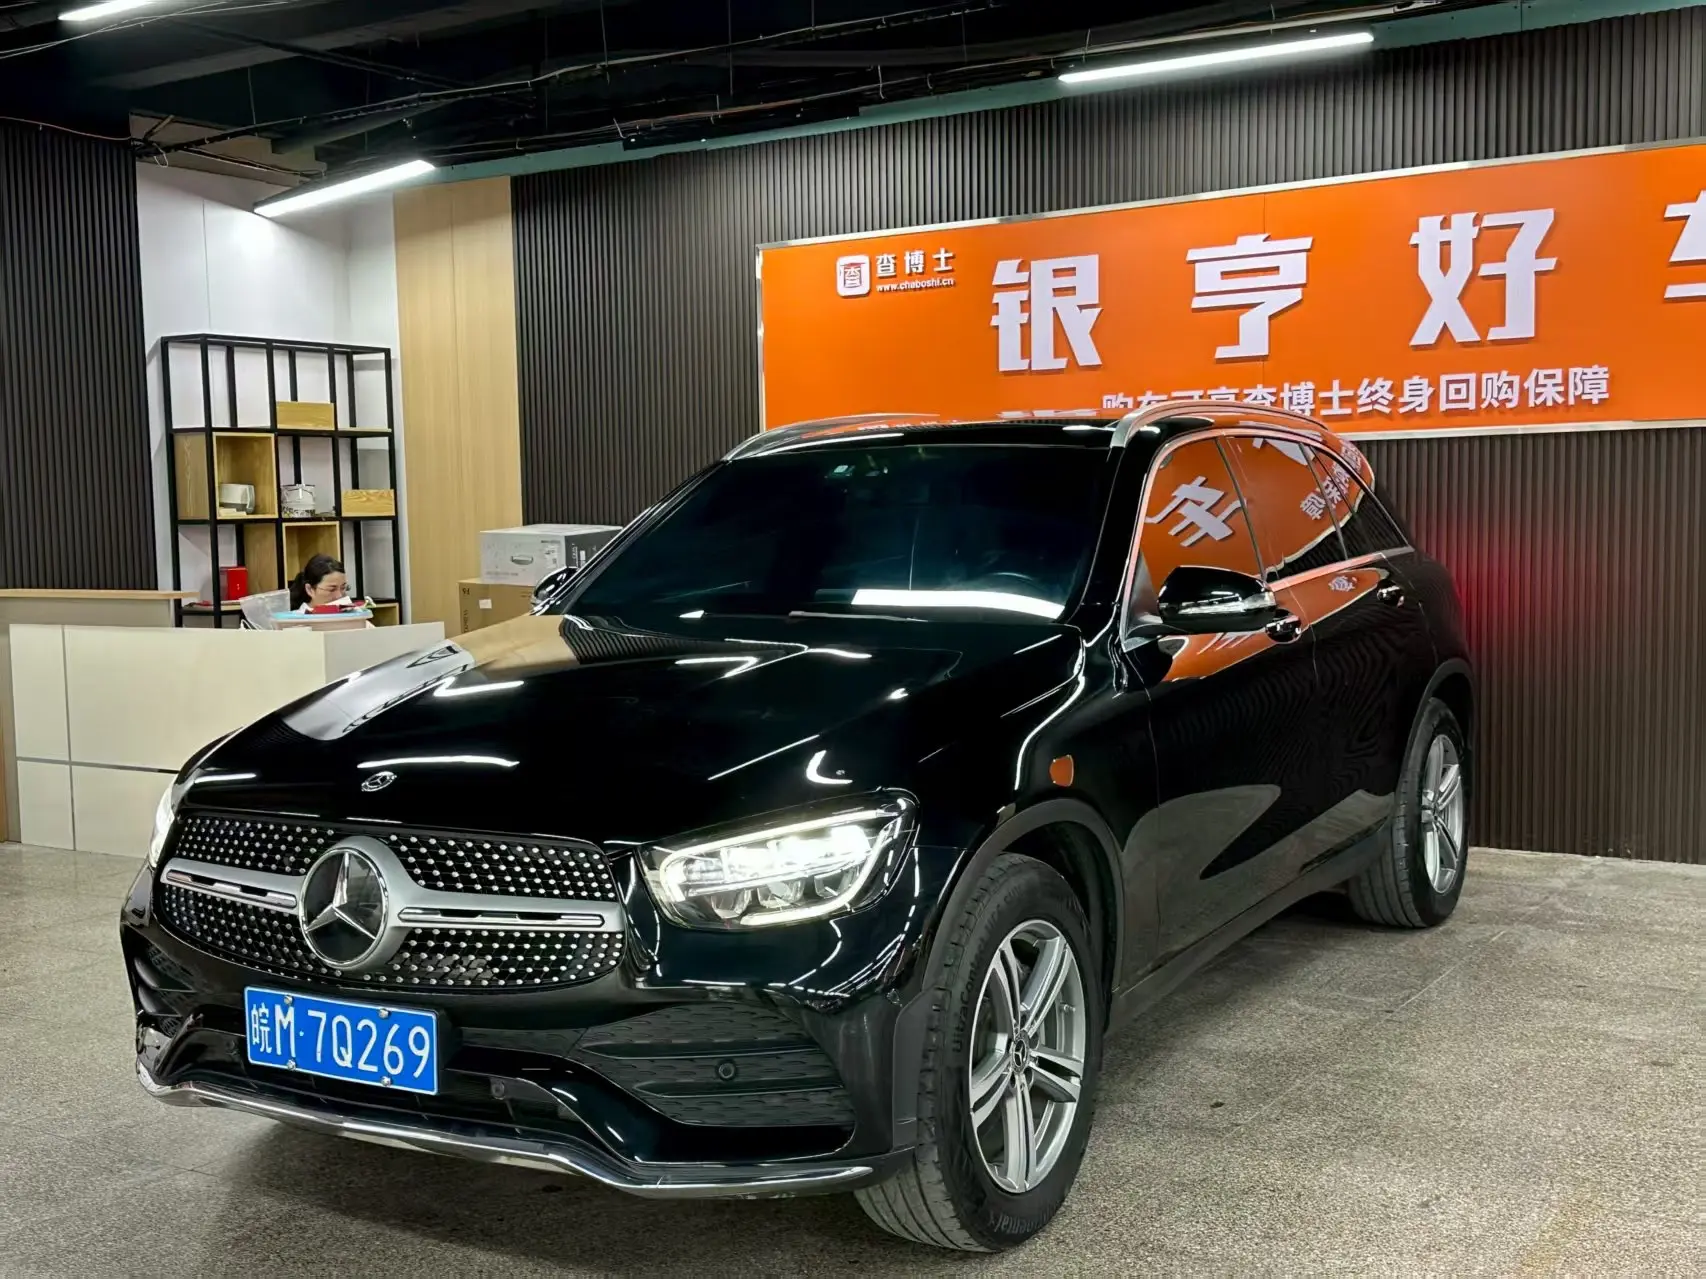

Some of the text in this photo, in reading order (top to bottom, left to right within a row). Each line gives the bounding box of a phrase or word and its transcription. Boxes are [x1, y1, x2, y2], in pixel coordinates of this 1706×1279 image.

[876, 247, 954, 278] 查博士
[876, 277, 955, 292] www.chaboshi.cn
